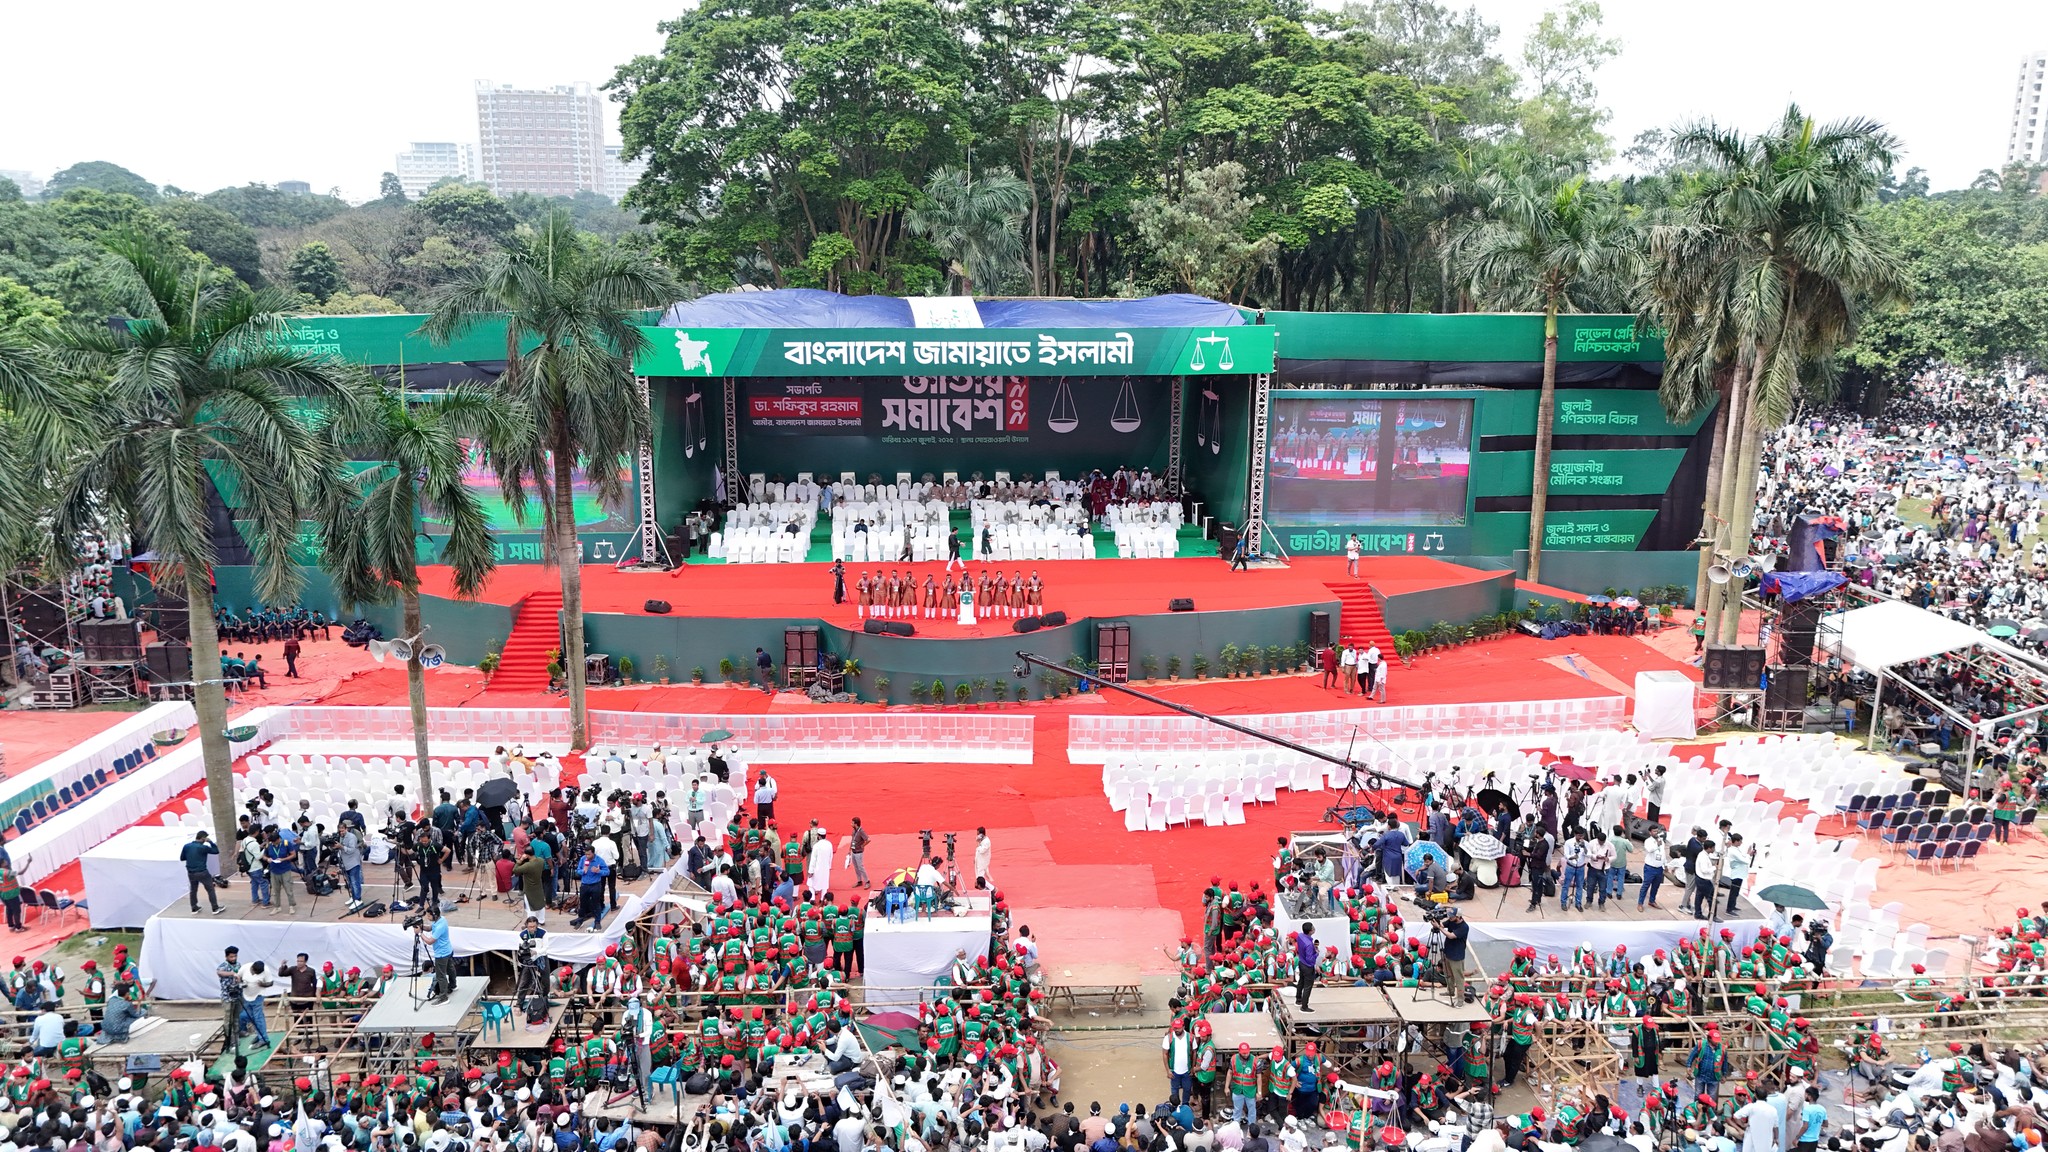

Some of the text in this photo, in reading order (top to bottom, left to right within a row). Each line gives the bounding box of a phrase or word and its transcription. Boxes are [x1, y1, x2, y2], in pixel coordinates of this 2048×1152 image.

[327, 329, 339, 340] ও
[1576, 328, 1611, 339] লেভেল
[784, 333, 1134, 367] বাংলাদেশ জামায়াতে ইসলামী
[1573, 338, 1641, 353] নিশ্চিতকরণ
[786, 382, 823, 395] সভাপতি
[755, 397, 859, 416] ডা. শফিকুর রহমান
[1561, 399, 1593, 414] জুলাই
[881, 398, 1004, 434] সমাবেশ
[1560, 411, 1639, 425] গণহত্যার বিচার
[1551, 460, 1604, 474] প্রয়োজনীয়
[1550, 472, 1624, 486] মৌলিক সংস্কার
[1546, 522, 1610, 536] জুলাই সনদ ও
[1289, 530, 1341, 552] জাতীয়
[1545, 534, 1636, 546] ঘোষণাপত্র বাস্তবায়ন
